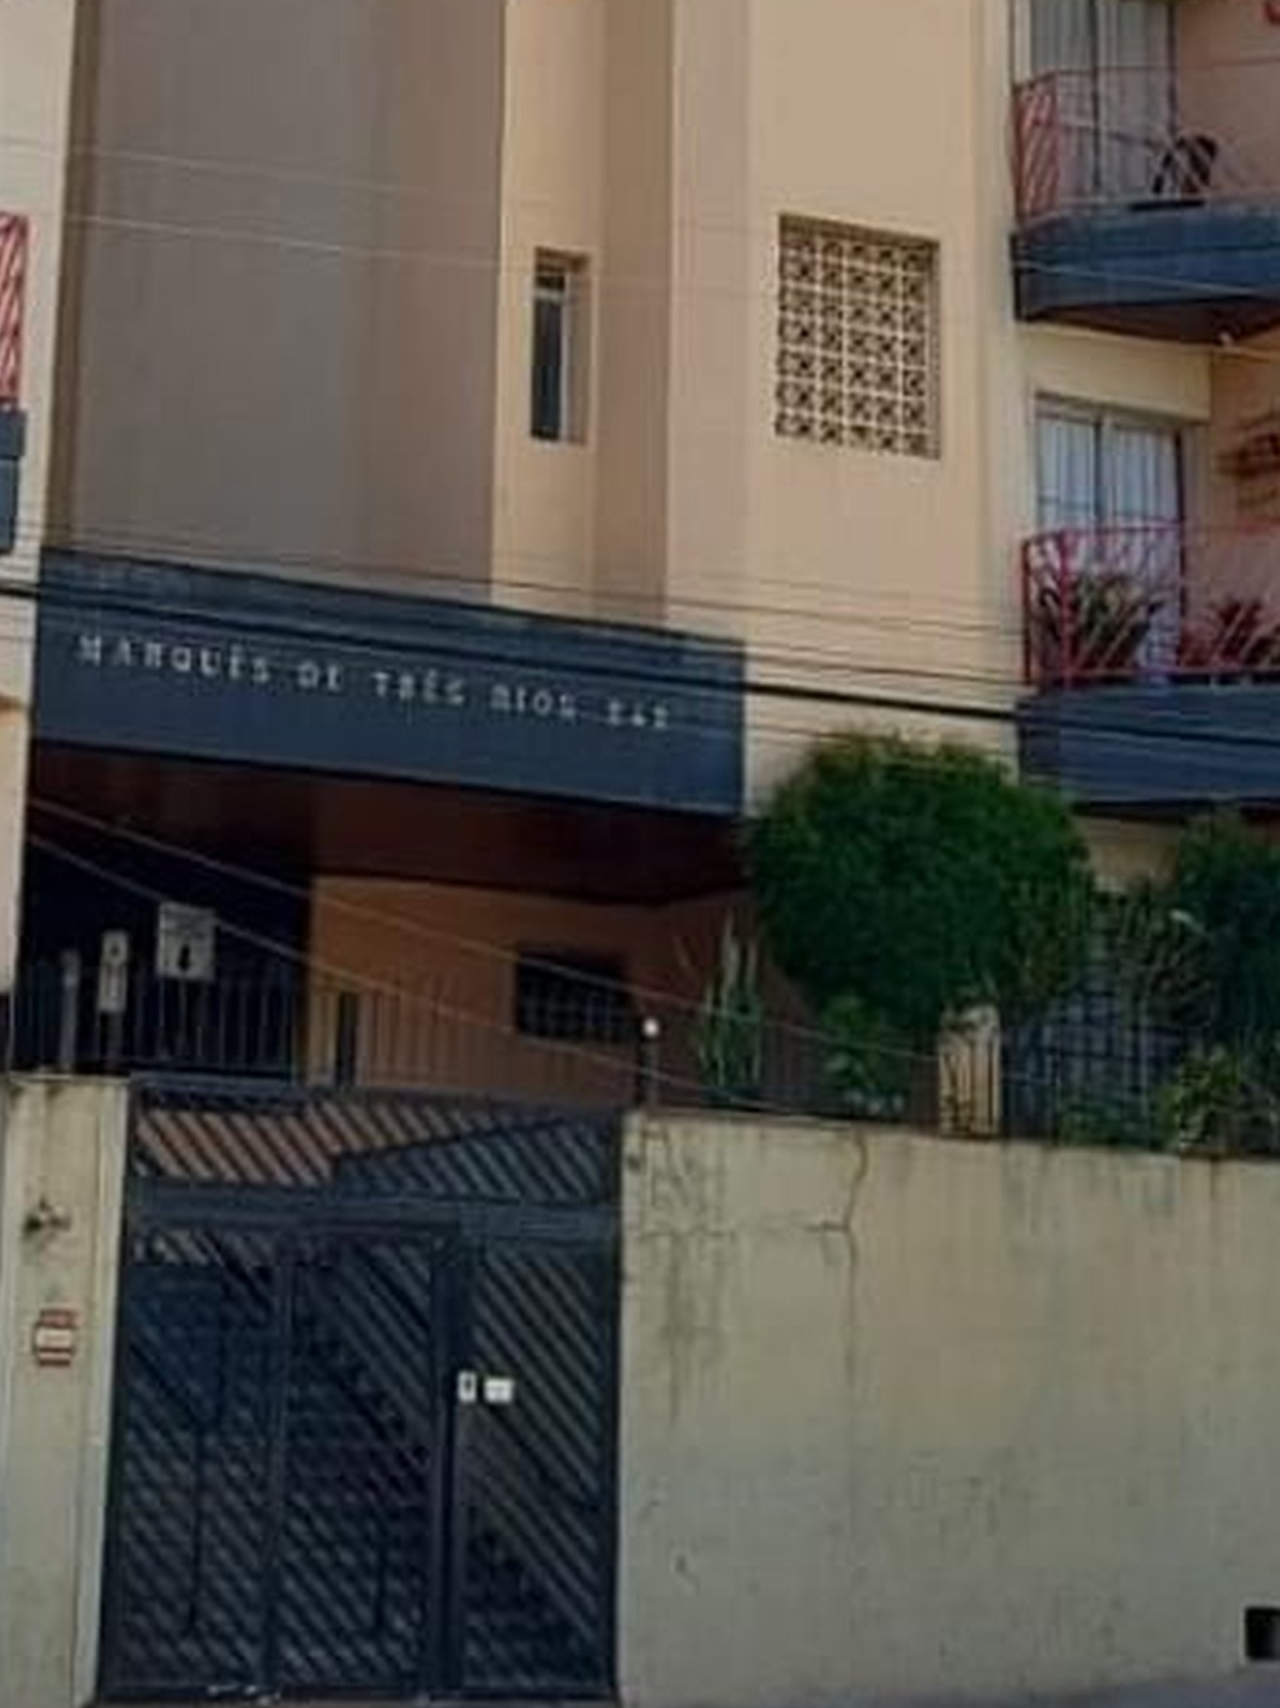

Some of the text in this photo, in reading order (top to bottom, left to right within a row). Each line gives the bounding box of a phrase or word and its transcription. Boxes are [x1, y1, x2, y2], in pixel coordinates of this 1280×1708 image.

[76, 633, 271, 685] MARQUÊS
[297, 659, 344, 692] DE
[373, 668, 465, 706] TRÊS
